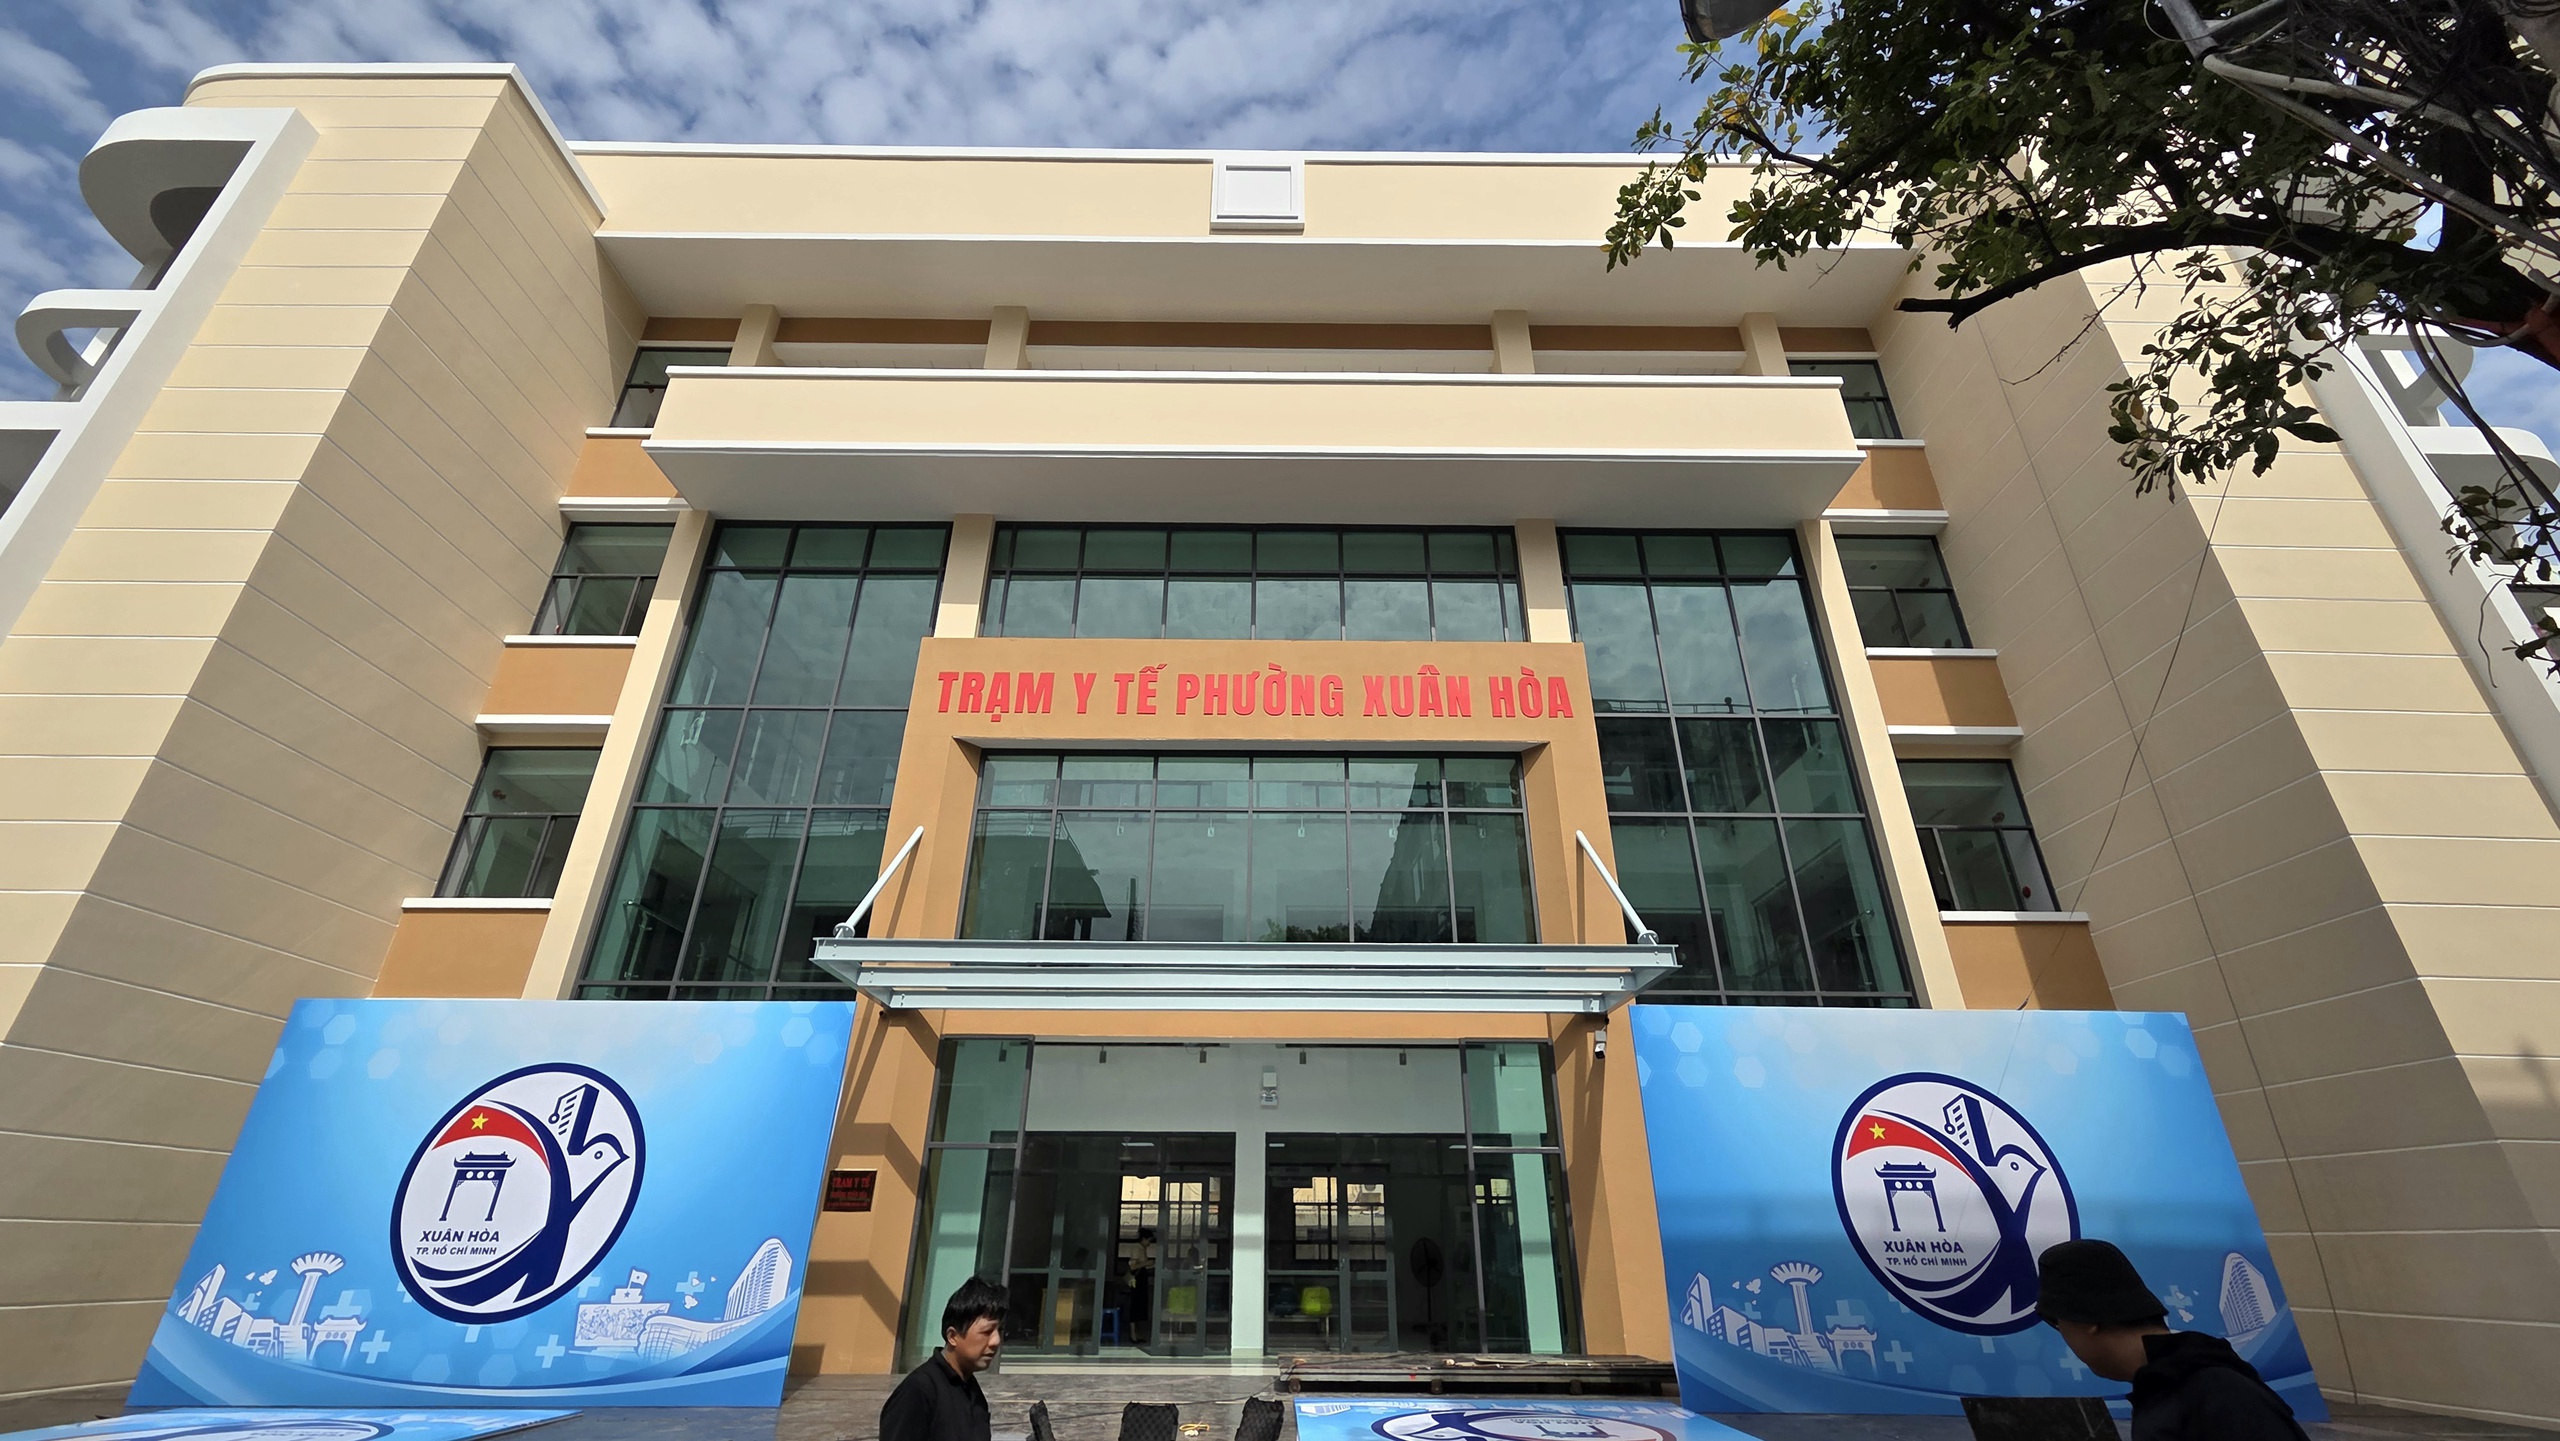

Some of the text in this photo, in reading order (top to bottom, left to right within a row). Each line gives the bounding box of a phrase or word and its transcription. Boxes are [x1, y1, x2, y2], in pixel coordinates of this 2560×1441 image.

[938, 661, 1574, 722] TRẠM Y TẾ PHƯỜNG XUÂN HÒA
[419, 1227, 500, 1243] XUÂN HÒA
[416, 1246, 429, 1255] TP.
[449, 1245, 469, 1256] CHÍ
[469, 1246, 498, 1256] MINH
[1883, 1238, 1964, 1254] XUÂN HÒA
[1886, 1257, 1901, 1266] TP.
[1920, 1256, 1939, 1266] CHÍ
[1940, 1257, 1968, 1267] MINH
